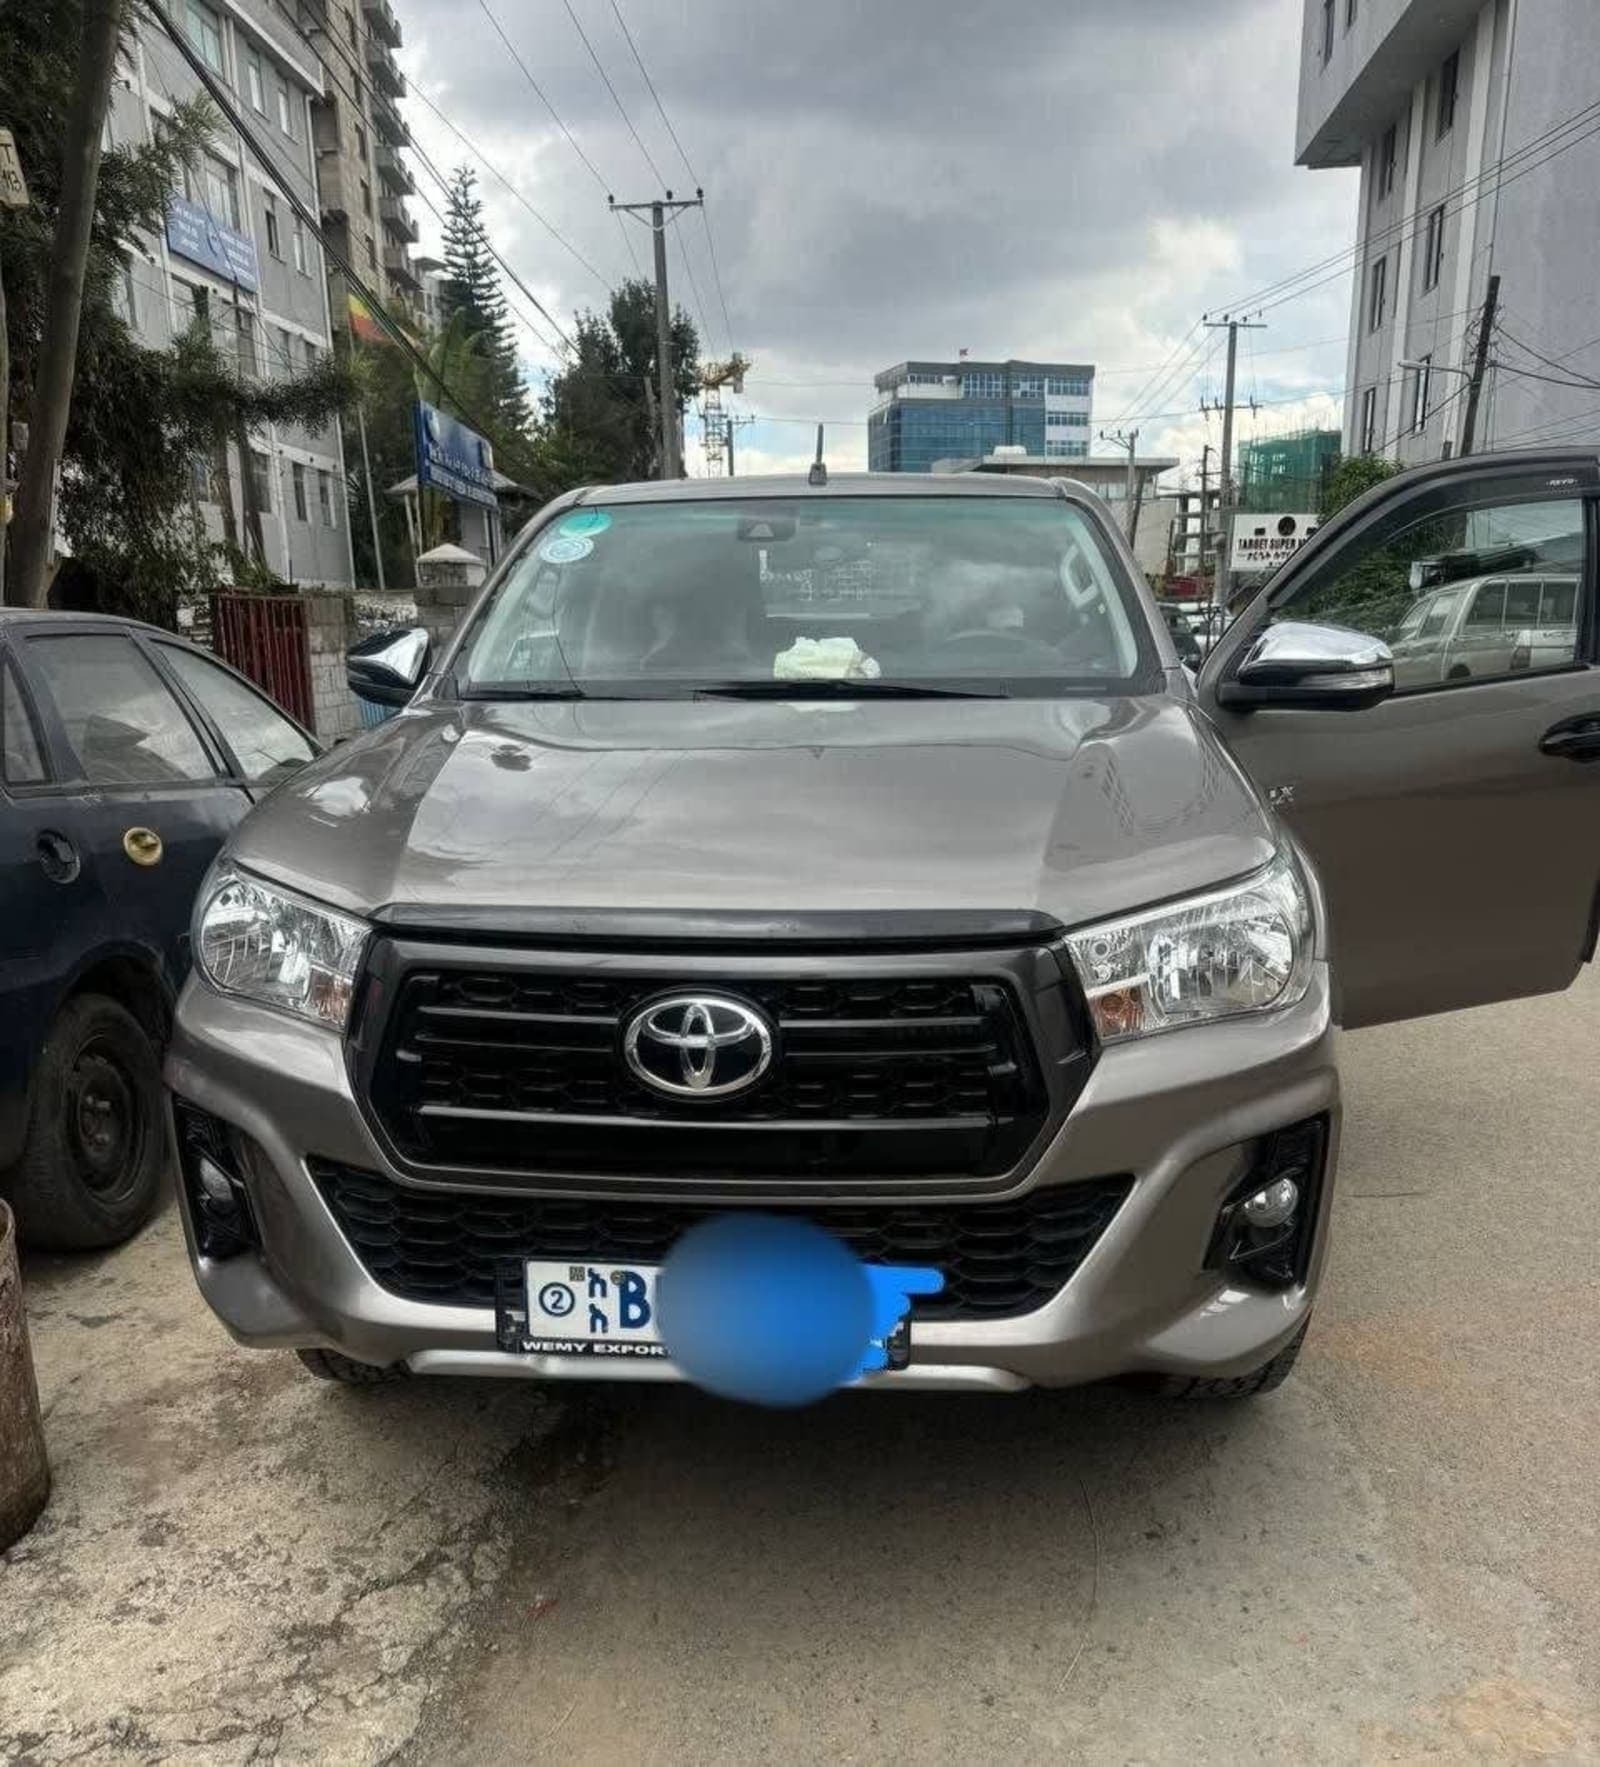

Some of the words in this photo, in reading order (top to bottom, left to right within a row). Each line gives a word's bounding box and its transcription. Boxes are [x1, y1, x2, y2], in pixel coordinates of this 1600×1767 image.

[1238, 538, 1268, 550] TARGET
[1270, 538, 1296, 550] SUPER
[523, 1341, 588, 1353] WEMY
[593, 1344, 672, 1356] EXPOR
